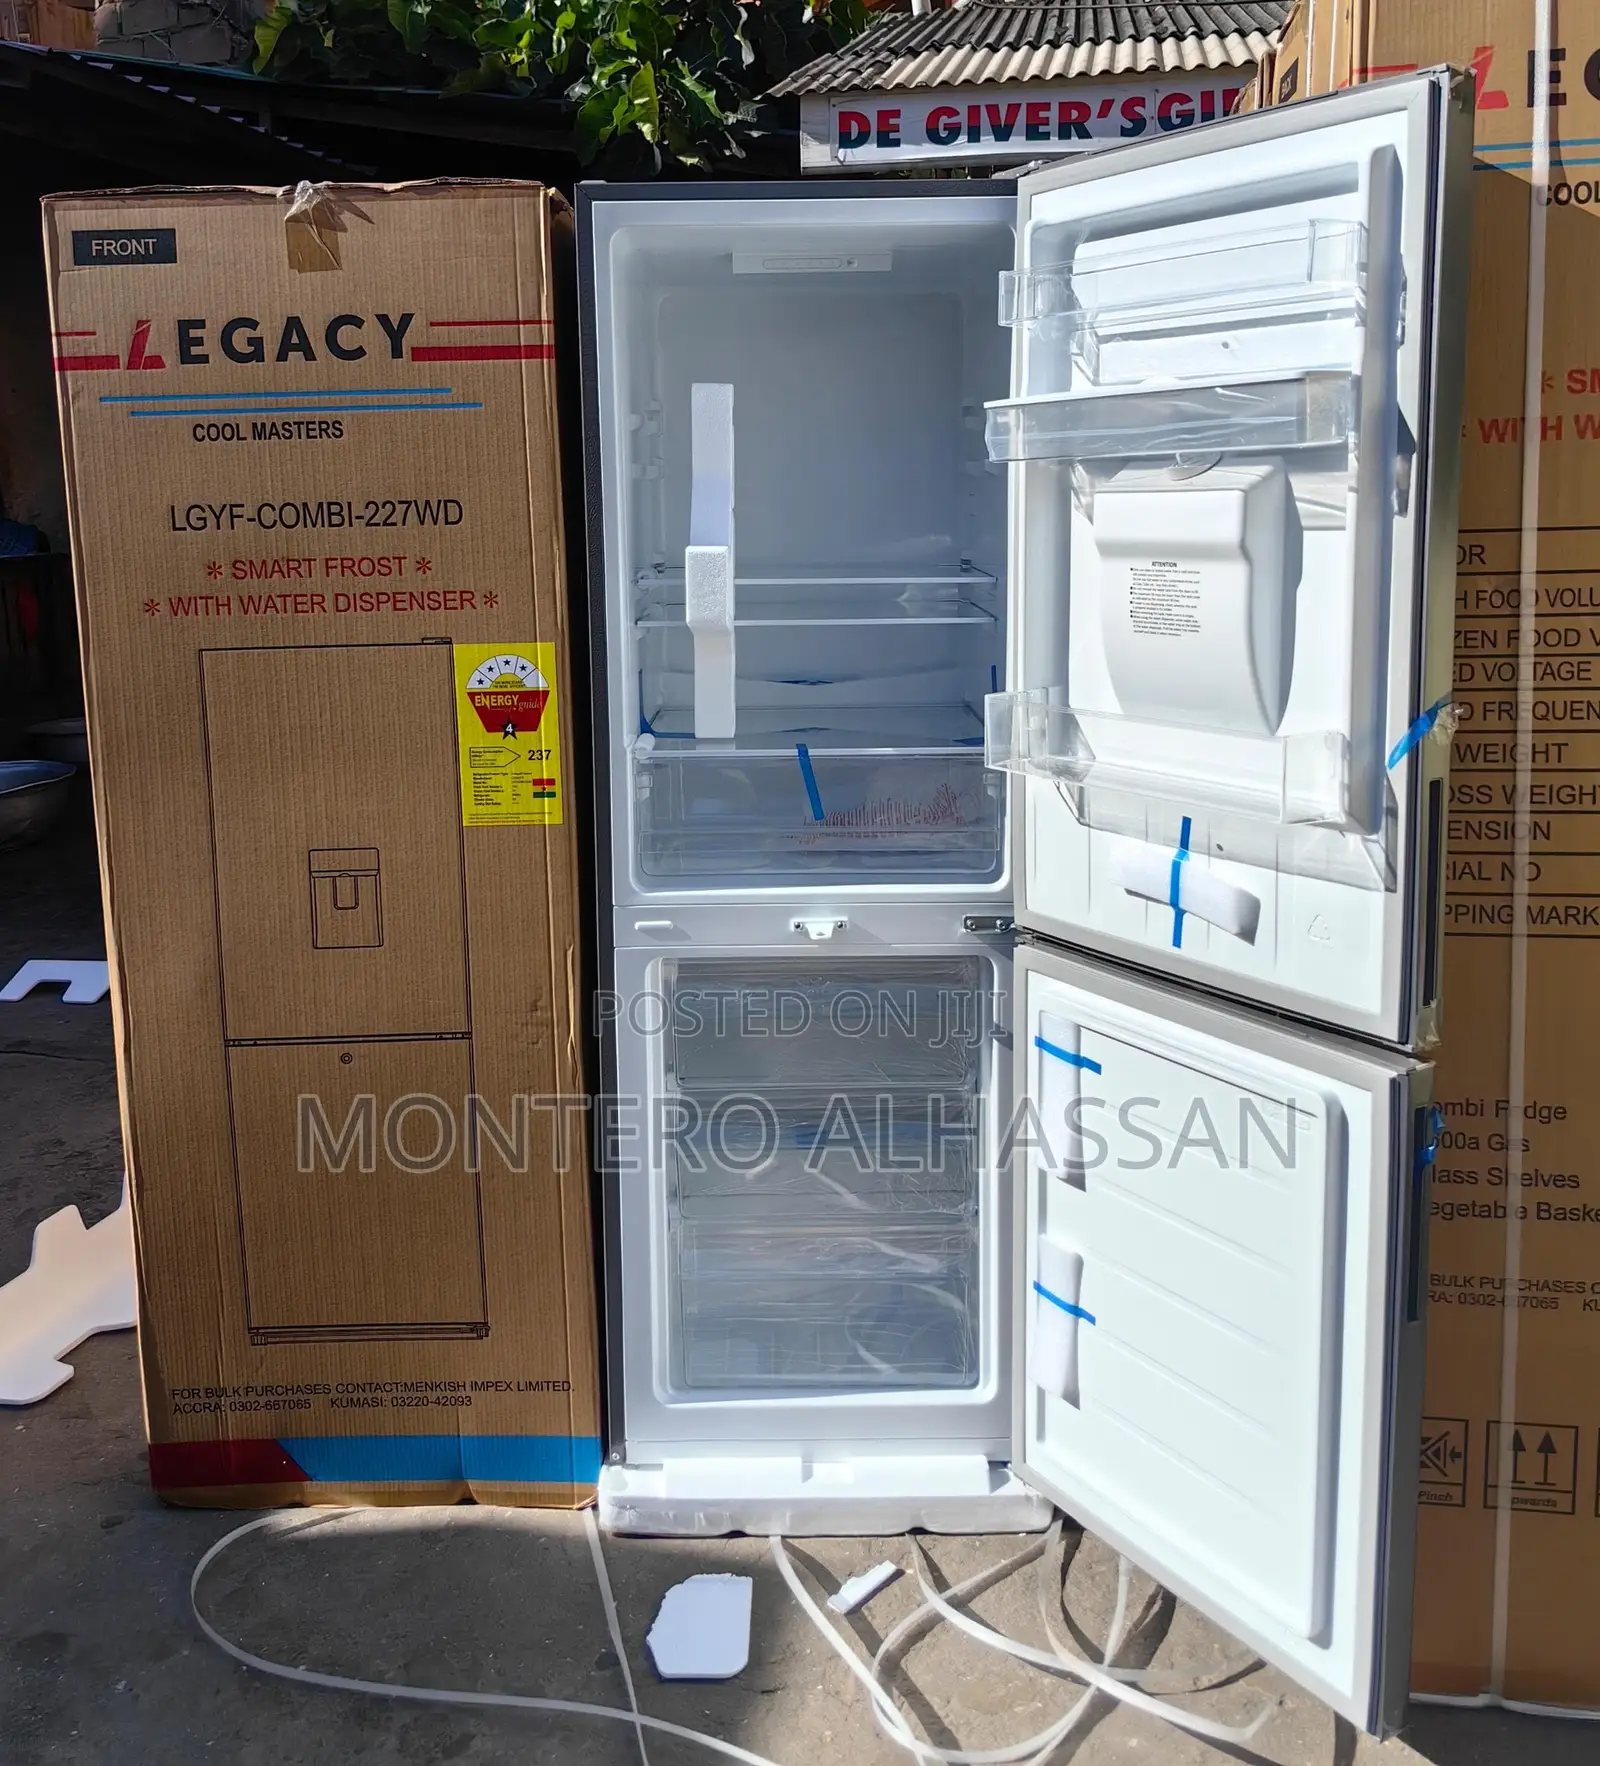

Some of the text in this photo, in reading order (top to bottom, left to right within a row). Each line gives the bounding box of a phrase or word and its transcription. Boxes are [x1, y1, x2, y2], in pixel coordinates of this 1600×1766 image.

[838, 109, 901, 149] DE
[925, 95, 1147, 146] GIVER'S
[91, 238, 158, 256] FRONT
[126, 312, 415, 371] LEGACY
[192, 420, 345, 442] COOL MASTERS
[170, 499, 464, 533] LGYF-COMBI-227WD
[231, 556, 408, 580] SMART FROST
[169, 590, 478, 617] WITH WATER DISPENSER
[1481, 661, 1593, 683] VOTAGE
[474, 693, 519, 709] ENERGY
[1483, 700, 1600, 722] FRQUEN
[505, 723, 513, 733] 4
[527, 749, 552, 761] 237
[1501, 784, 1600, 805] WEIGH
[1446, 860, 1493, 882] IAL
[1436, 1131, 1531, 1152] 00a Gs
[1430, 1200, 1528, 1221] egetabe
[1479, 1276, 1586, 1295] PUCHASES
[1457, 1292, 1560, 1310] 0302-7065
[172, 1388, 201, 1400] FOR
[205, 1386, 242, 1398] BULK
[245, 1383, 332, 1397] PURCHASES
[470, 1380, 513, 1392] IMPEX
[517, 1380, 575, 1392] LIMITED.
[172, 1395, 472, 1415] ACCRA: 0302-667065 KUMASI: 03220-42093
